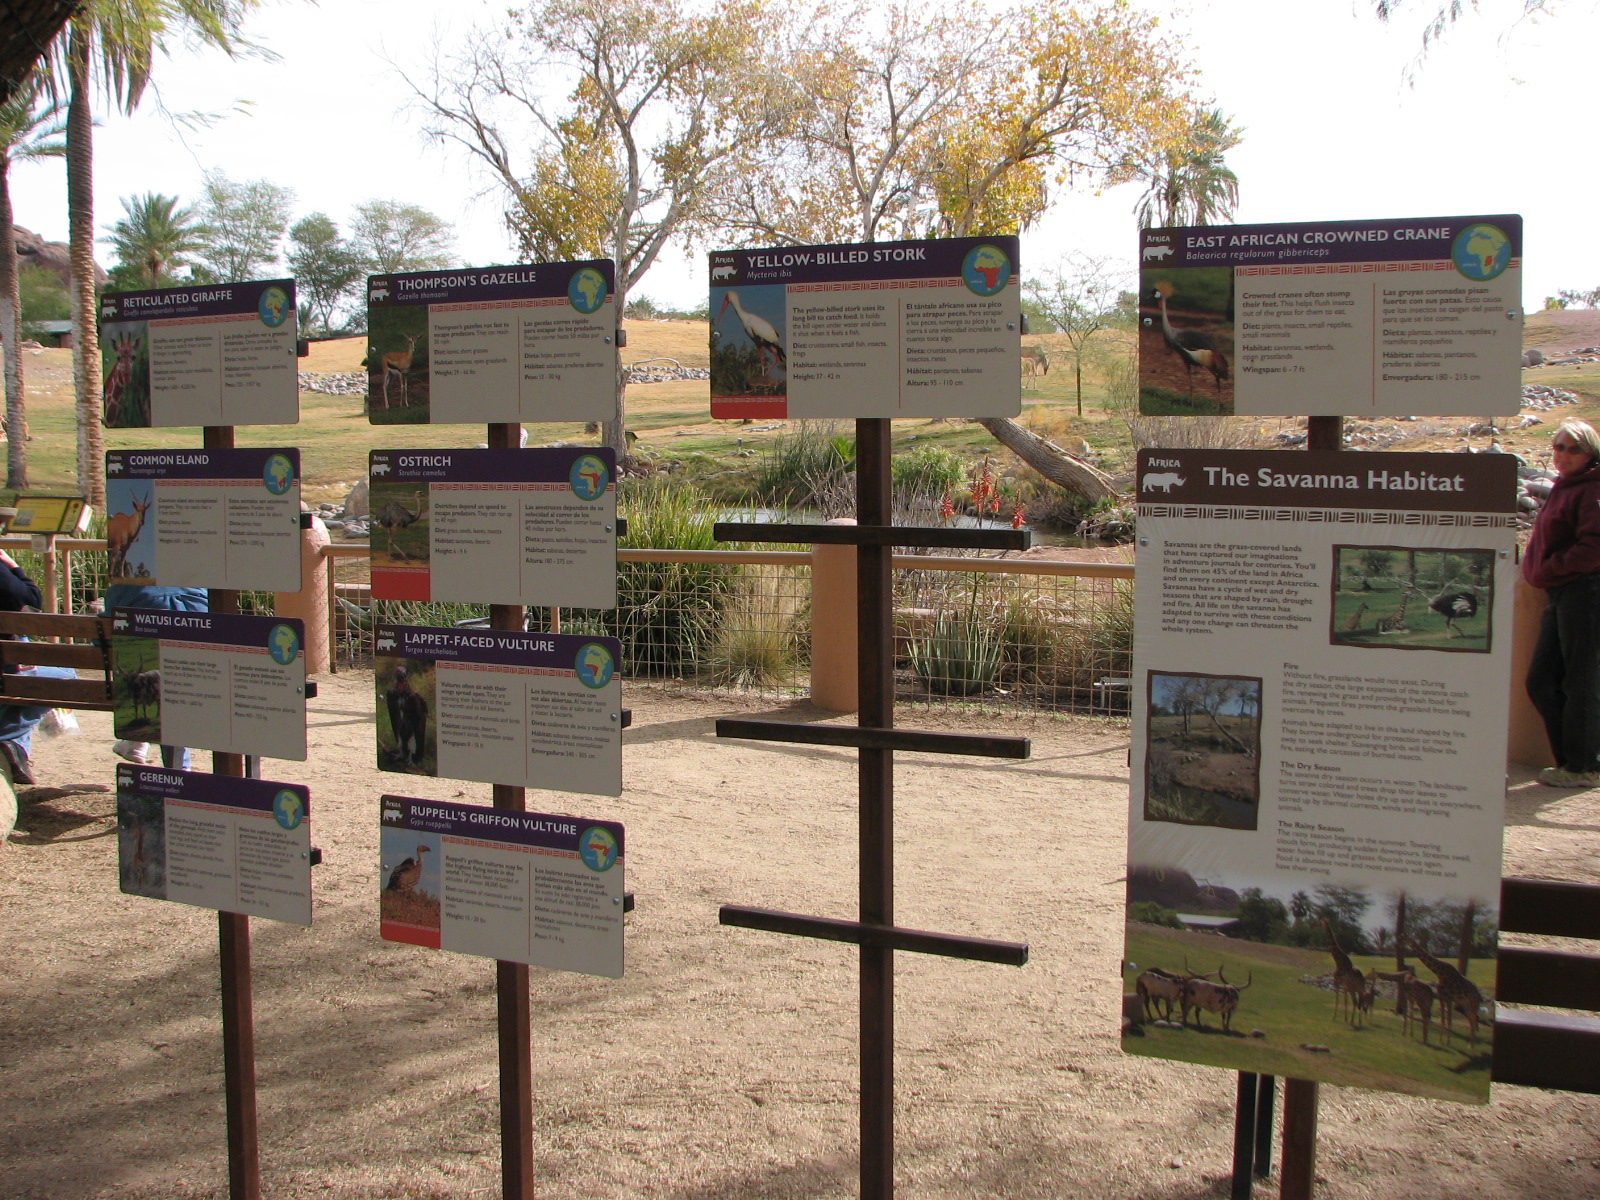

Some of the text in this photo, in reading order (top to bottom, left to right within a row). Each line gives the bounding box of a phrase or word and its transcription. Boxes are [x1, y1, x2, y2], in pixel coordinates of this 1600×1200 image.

[1187, 228, 1450, 248] EAST AFRICAN CROWNED CRANE
[747, 248, 926, 267] YELLOW-BILLED STORK
[1186, 249, 1329, 260] Balearica regulorum gibbericeps
[747, 269, 792, 279] Mycteria ibis
[398, 272, 536, 290] THOMPSON'S GAZELLE
[124, 290, 232, 308] RETICULATED GIRAFFE
[806, 306, 843, 314] yellow-billed
[130, 455, 209, 465] COMMON ELAND
[399, 456, 451, 466] OSTRICH
[1148, 458, 1180, 468] AFRICA
[1203, 467, 1465, 492] The Savanna Habitat
[1228, 543, 1279, 551] grass-covered
[1250, 553, 1298, 561] imaginations
[1250, 578, 1274, 586] except
[1277, 579, 1319, 587] Antarctica.
[1286, 588, 1298, 596] dry
[1224, 594, 1249, 603] shaped
[1252, 595, 1260, 603] by
[1282, 597, 1312, 605] drought
[1162, 609, 1191, 617] adapted
[135, 614, 211, 628] WATUSI CATTLE
[1208, 619, 1233, 627] change
[1251, 621, 1283, 629] threaten
[1186, 627, 1213, 635] system.
[405, 633, 555, 651] LAPPET-FACED VULTURE
[1314, 764, 1340, 772] Season
[140, 772, 184, 786] GERENUK
[411, 805, 577, 835] RUPPELL'S GRIFFON VULTURE
[1295, 822, 1315, 830] Rainy
[1317, 824, 1344, 832] Season
